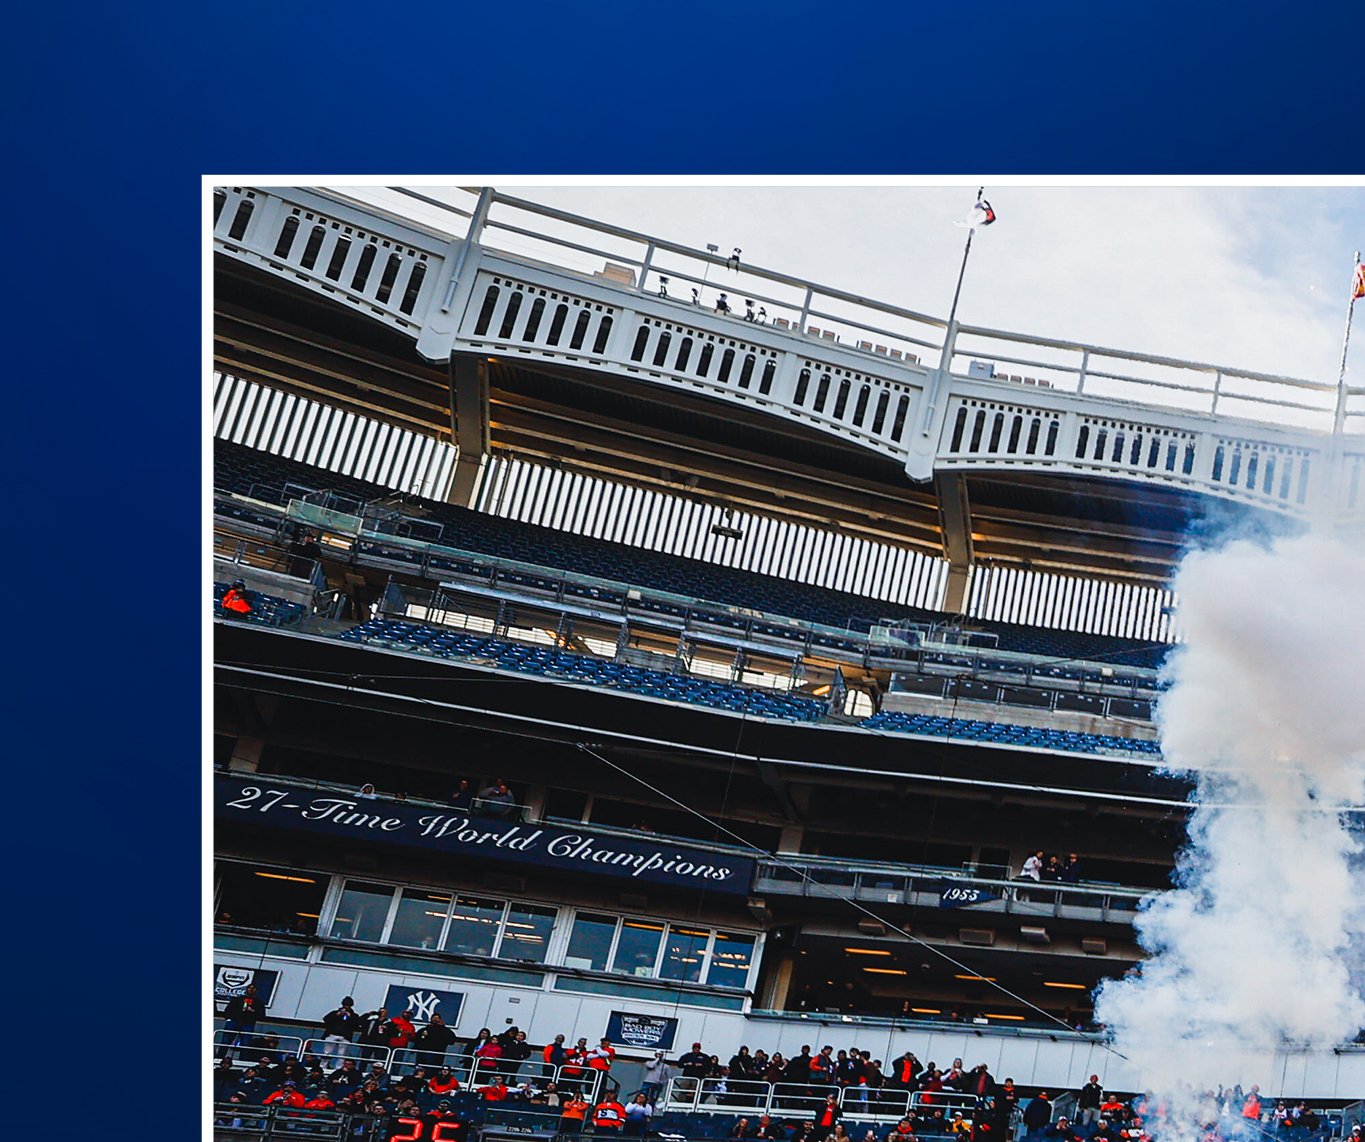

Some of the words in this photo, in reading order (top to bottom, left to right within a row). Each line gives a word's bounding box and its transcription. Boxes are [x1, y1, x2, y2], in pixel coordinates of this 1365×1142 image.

[226, 787, 404, 832] 27-Time
[415, 813, 533, 854] World
[546, 831, 735, 882] Champions
